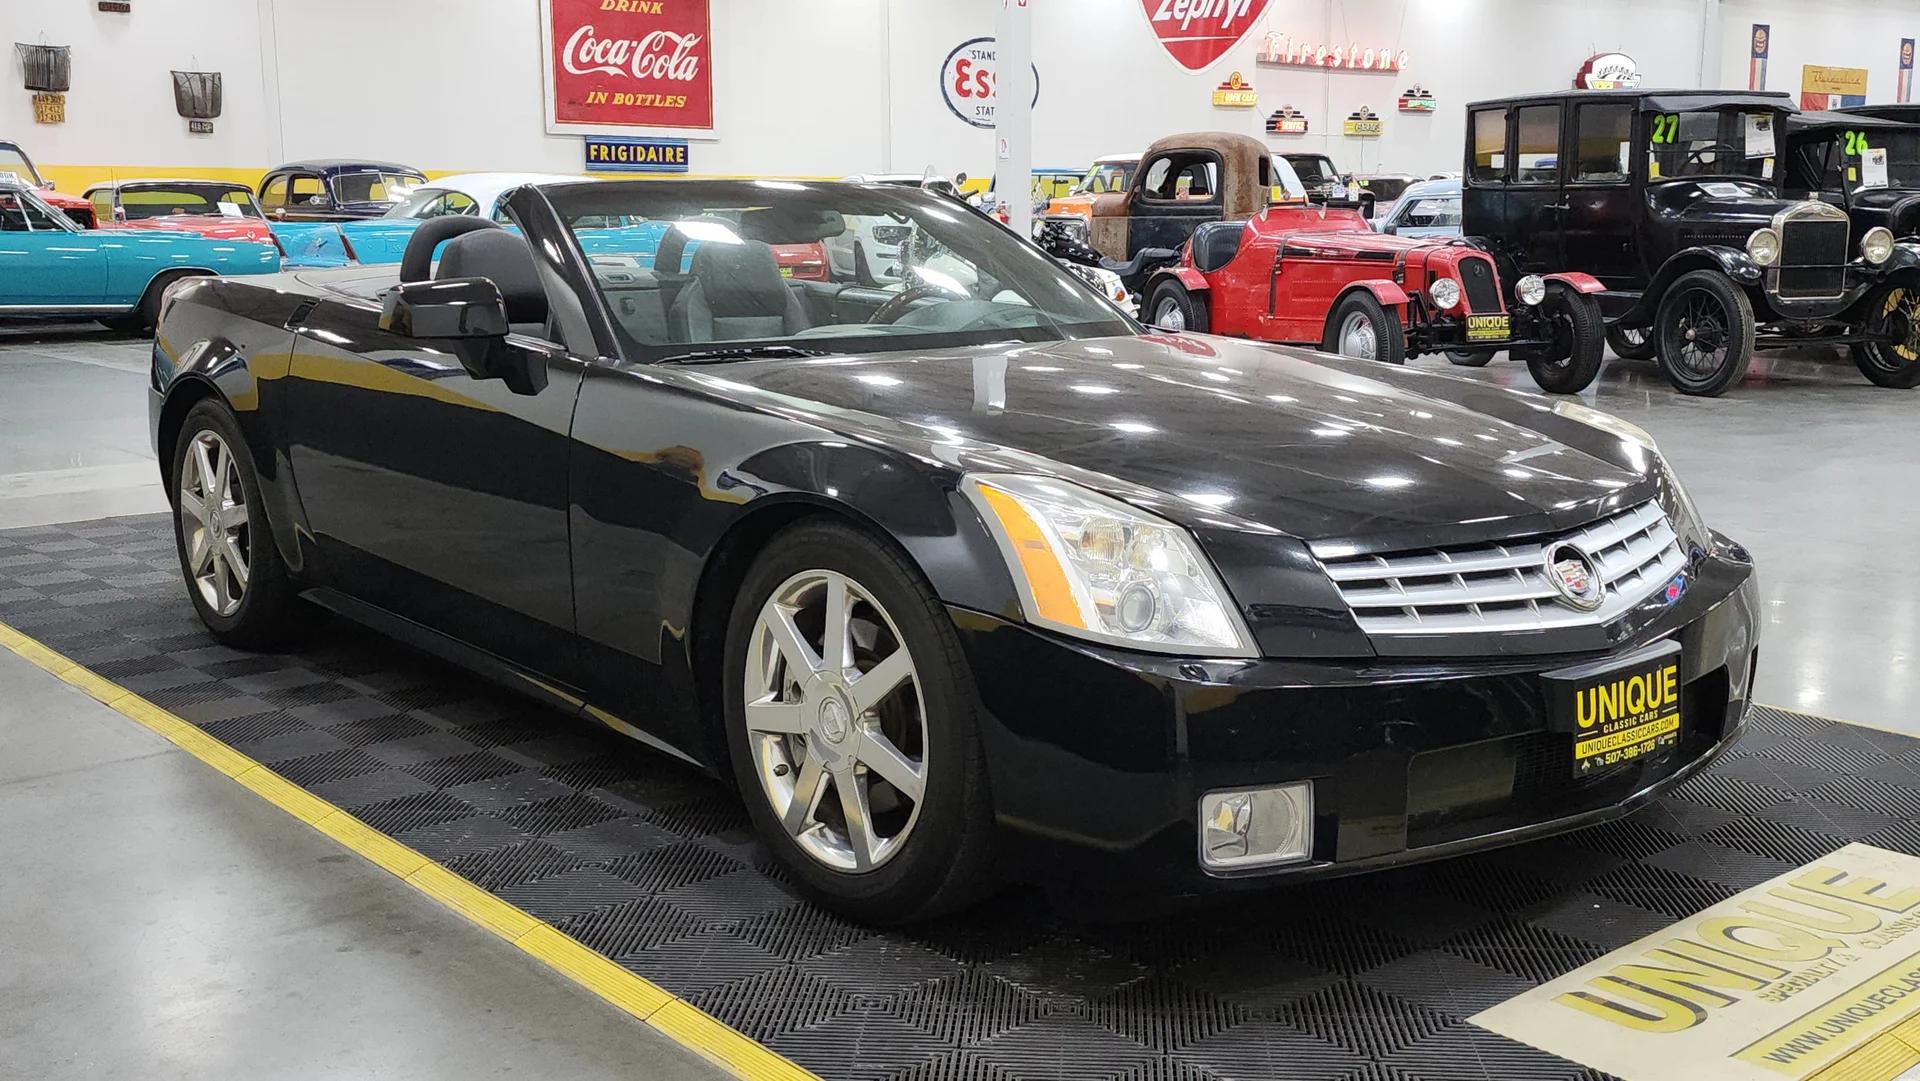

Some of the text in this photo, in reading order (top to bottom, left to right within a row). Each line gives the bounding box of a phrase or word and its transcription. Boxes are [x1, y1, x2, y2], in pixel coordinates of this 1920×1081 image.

[600, 0, 664, 14] DRINK
[562, 25, 703, 81] Coca-Cola
[1265, 31, 1409, 70] Firestone
[585, 91, 687, 107] IN BOTTLES
[1652, 115, 1679, 143] 27
[1845, 131, 1868, 155] 26
[590, 144, 685, 163] FRIGIDAIRE
[1468, 316, 1509, 328] UNIQUE
[1577, 665, 1678, 728] UNIQUE
[1603, 709, 1659, 734] CLASSIC CARS
[1551, 866, 1920, 1033] UNIQUE
[1756, 957, 1848, 1002] SPECIALTY
[1761, 964, 1920, 1064] WWW.UNIQUECLAS
